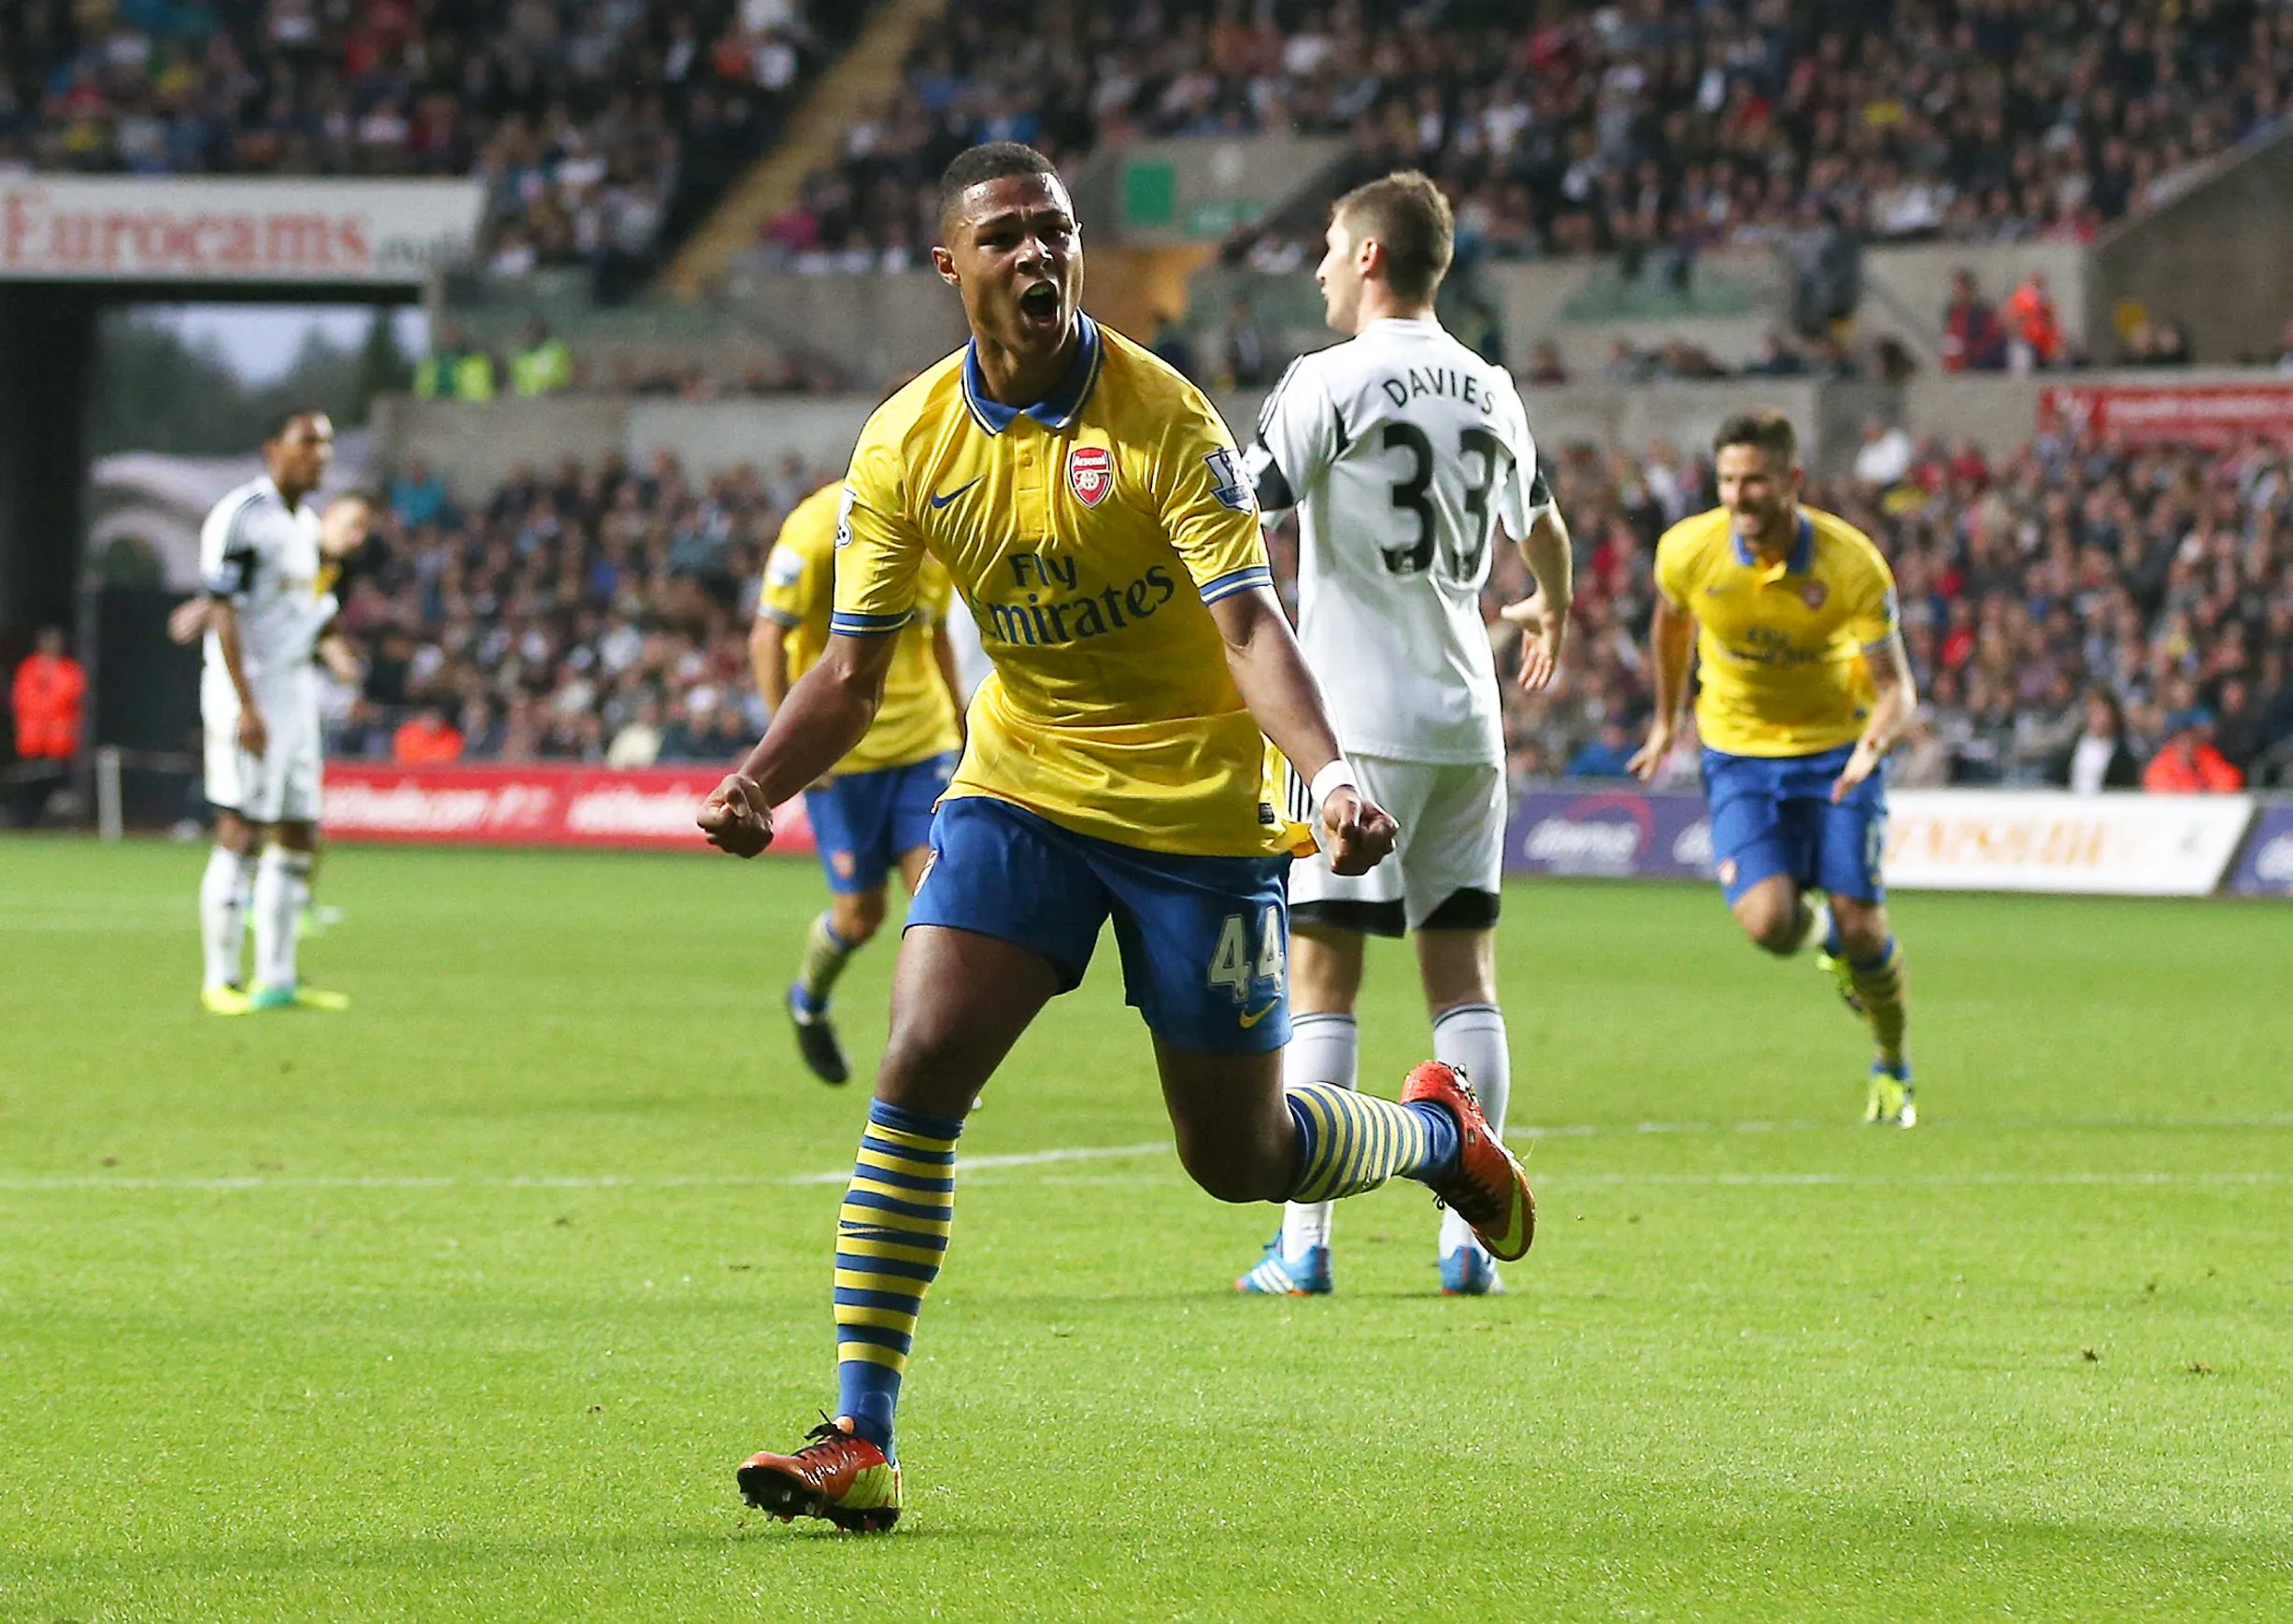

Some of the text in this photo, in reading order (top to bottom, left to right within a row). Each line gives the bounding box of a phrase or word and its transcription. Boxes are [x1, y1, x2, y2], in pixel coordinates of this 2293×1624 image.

[1382, 366, 1496, 408] DAVIES
[1075, 455, 1106, 466] Arsenal
[1381, 422, 1497, 581] 33
[1008, 552, 1076, 591] Fly
[1208, 905, 1286, 1004] 44
